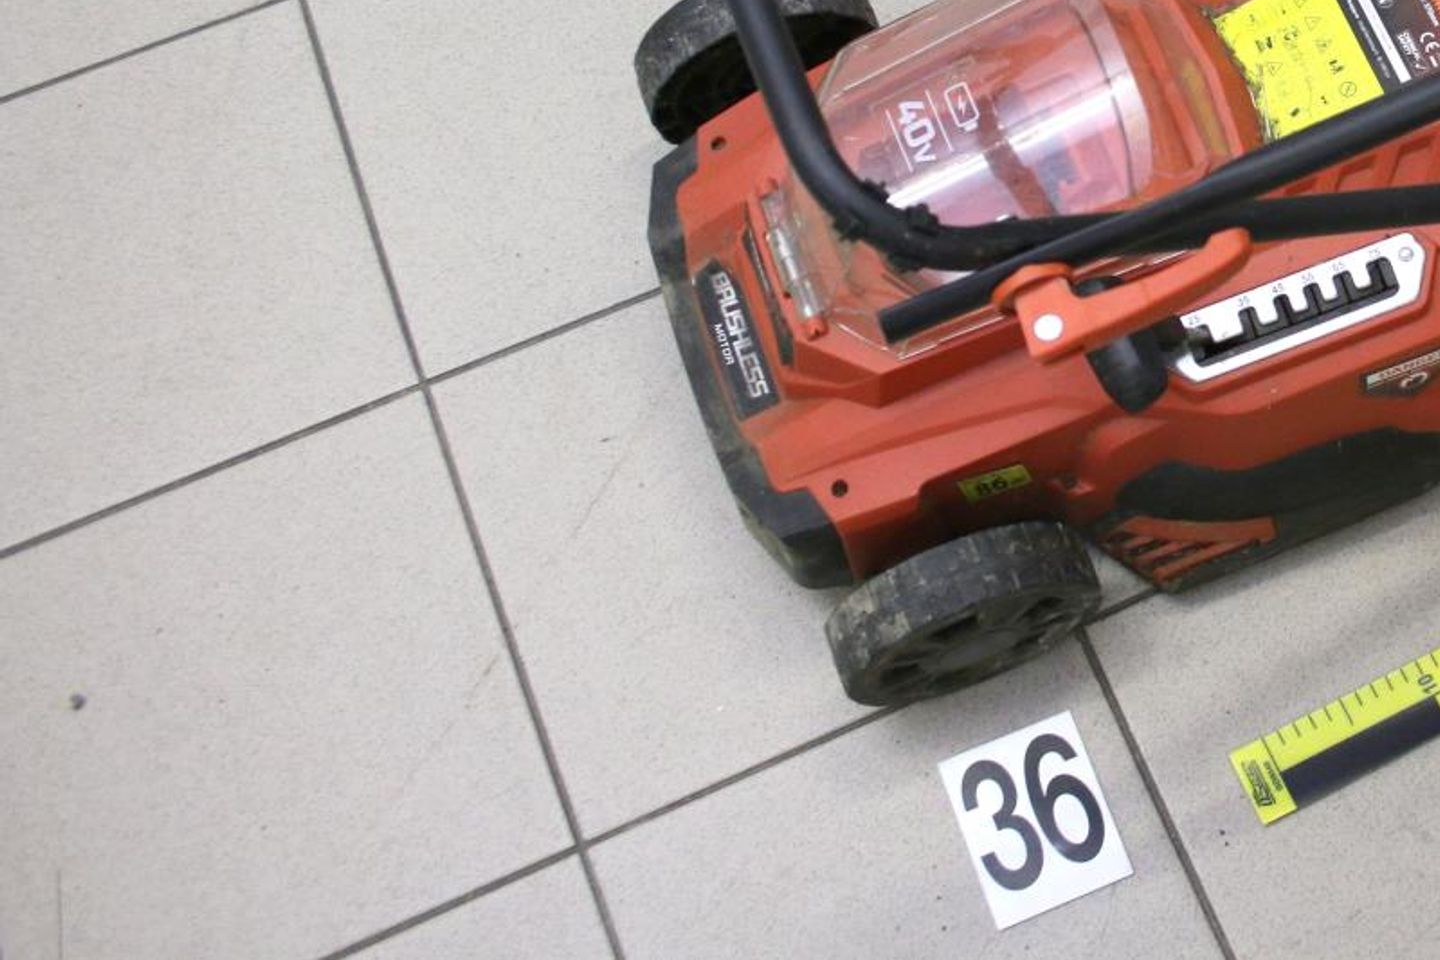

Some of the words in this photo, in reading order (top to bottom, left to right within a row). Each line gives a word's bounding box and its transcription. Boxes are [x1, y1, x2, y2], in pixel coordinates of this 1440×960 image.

[1419, 31, 1440, 54] CE
[898, 100, 937, 164] 40V
[710, 271, 770, 399] BRUSHLESS
[714, 324, 735, 366] MOTOR
[1417, 674, 1437, 694] 10
[961, 733, 1105, 891] 36
